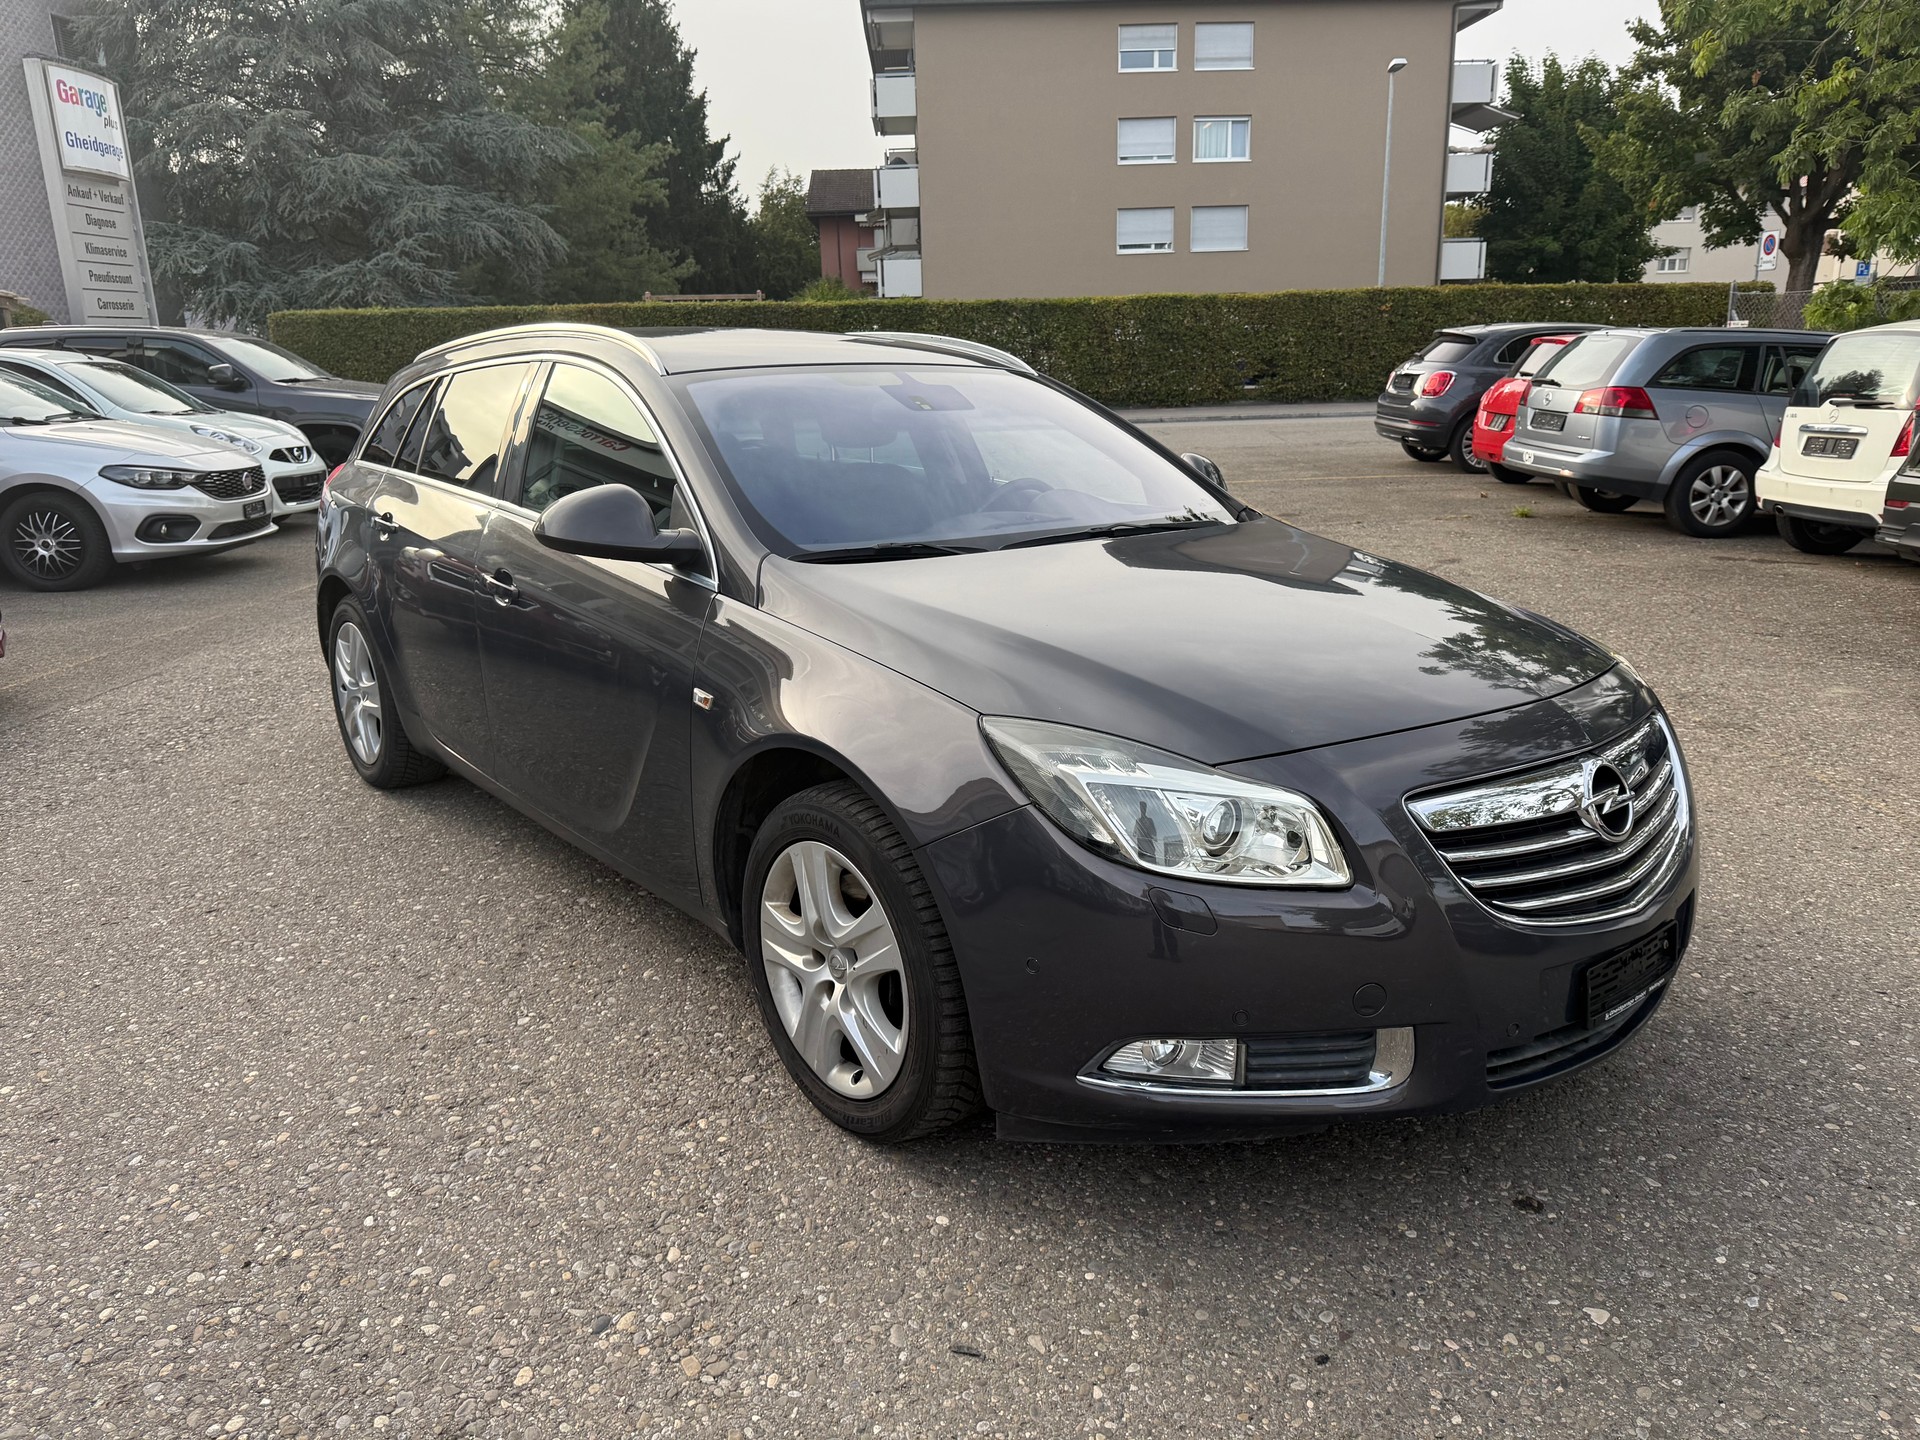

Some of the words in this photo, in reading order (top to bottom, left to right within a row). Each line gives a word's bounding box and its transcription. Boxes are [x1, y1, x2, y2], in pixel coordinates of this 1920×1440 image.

[56, 79, 107, 117] Garage
[104, 115, 118, 130] plus
[65, 131, 123, 161] Gheidgarage
[68, 184, 92, 200] Ankauf
[98, 190, 124, 205] Verkauf
[85, 213, 116, 229] Diagnose
[85, 242, 127, 258] Klimaservice
[89, 270, 133, 284] Pneudiscount
[97, 298, 134, 310] Carrosserie
[787, 813, 840, 838] YOKOHAMA
